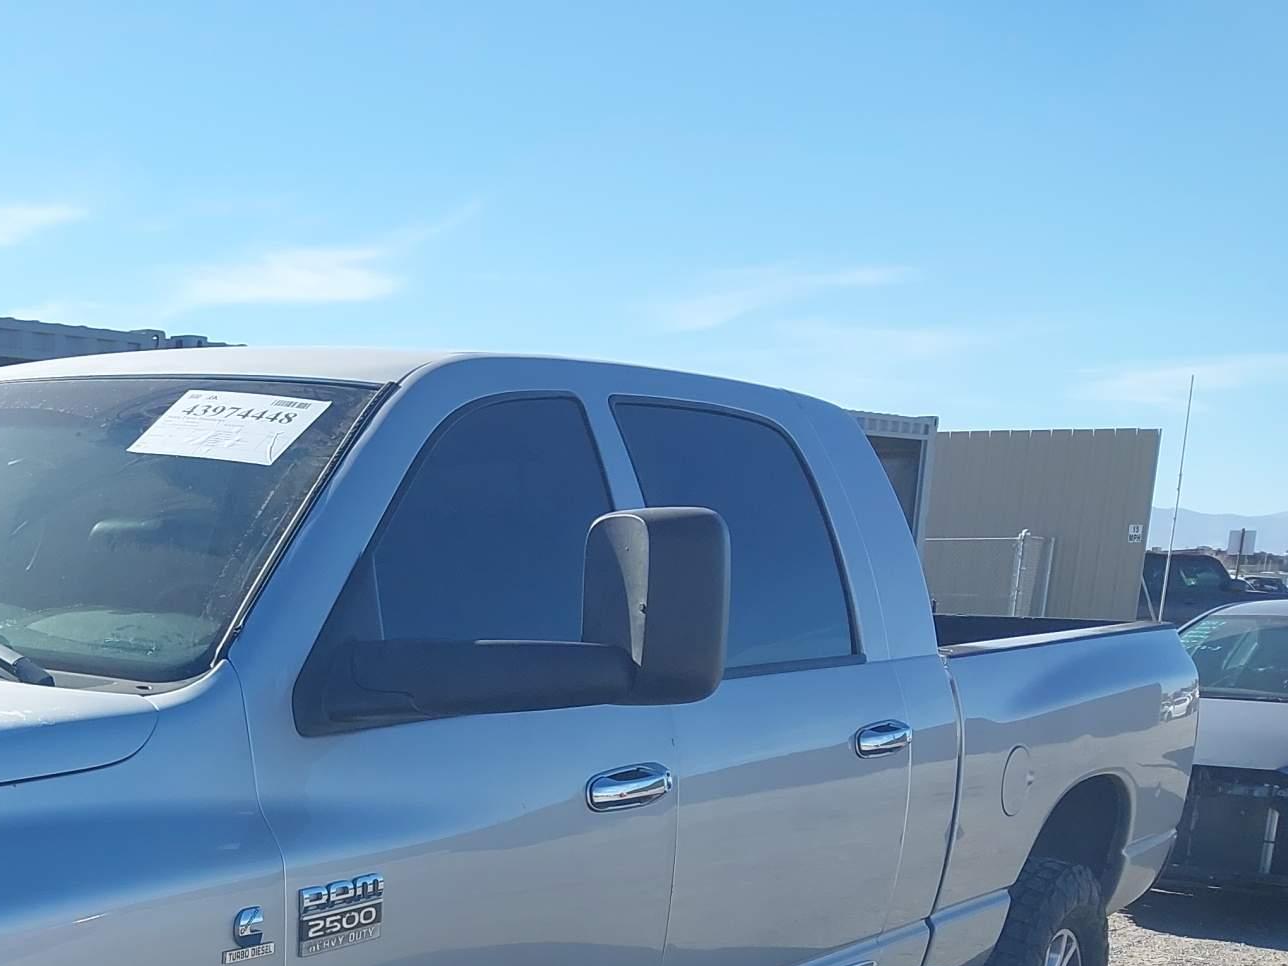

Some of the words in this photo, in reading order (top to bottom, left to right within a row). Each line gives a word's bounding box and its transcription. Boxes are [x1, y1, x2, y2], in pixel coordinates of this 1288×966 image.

[182, 403, 298, 425] 43974448
[298, 872, 384, 914] RAM
[308, 907, 377, 938] 2500
[349, 926, 376, 943] DUTY
[228, 948, 250, 961] TURBO
[251, 944, 273, 957] DIESEL
